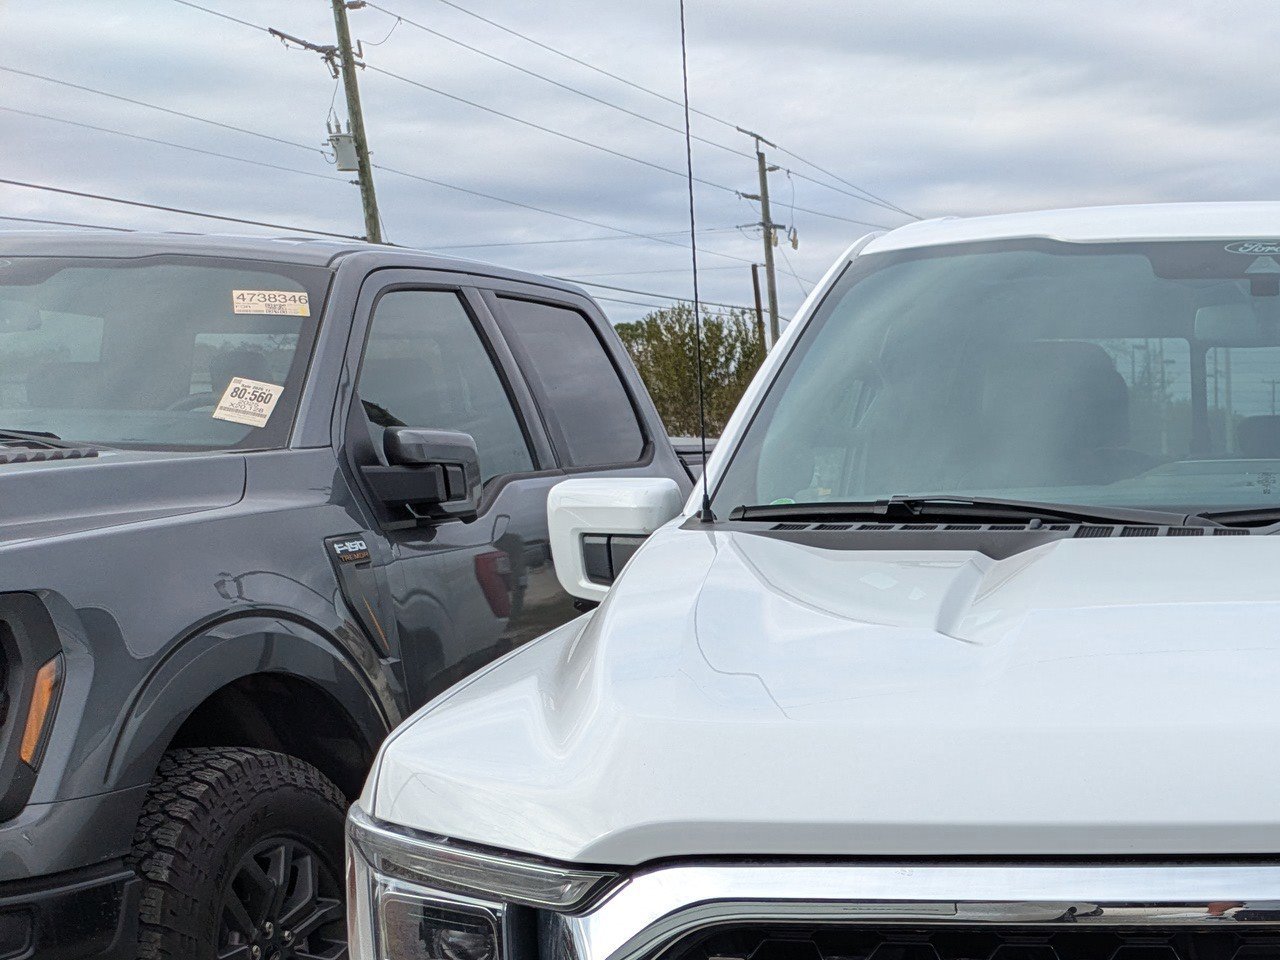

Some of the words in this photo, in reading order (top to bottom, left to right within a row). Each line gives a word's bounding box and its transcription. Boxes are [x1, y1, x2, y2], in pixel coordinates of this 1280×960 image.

[236, 293, 308, 304] 4738346
[230, 386, 273, 404] 80:560
[333, 540, 368, 554] F-150
